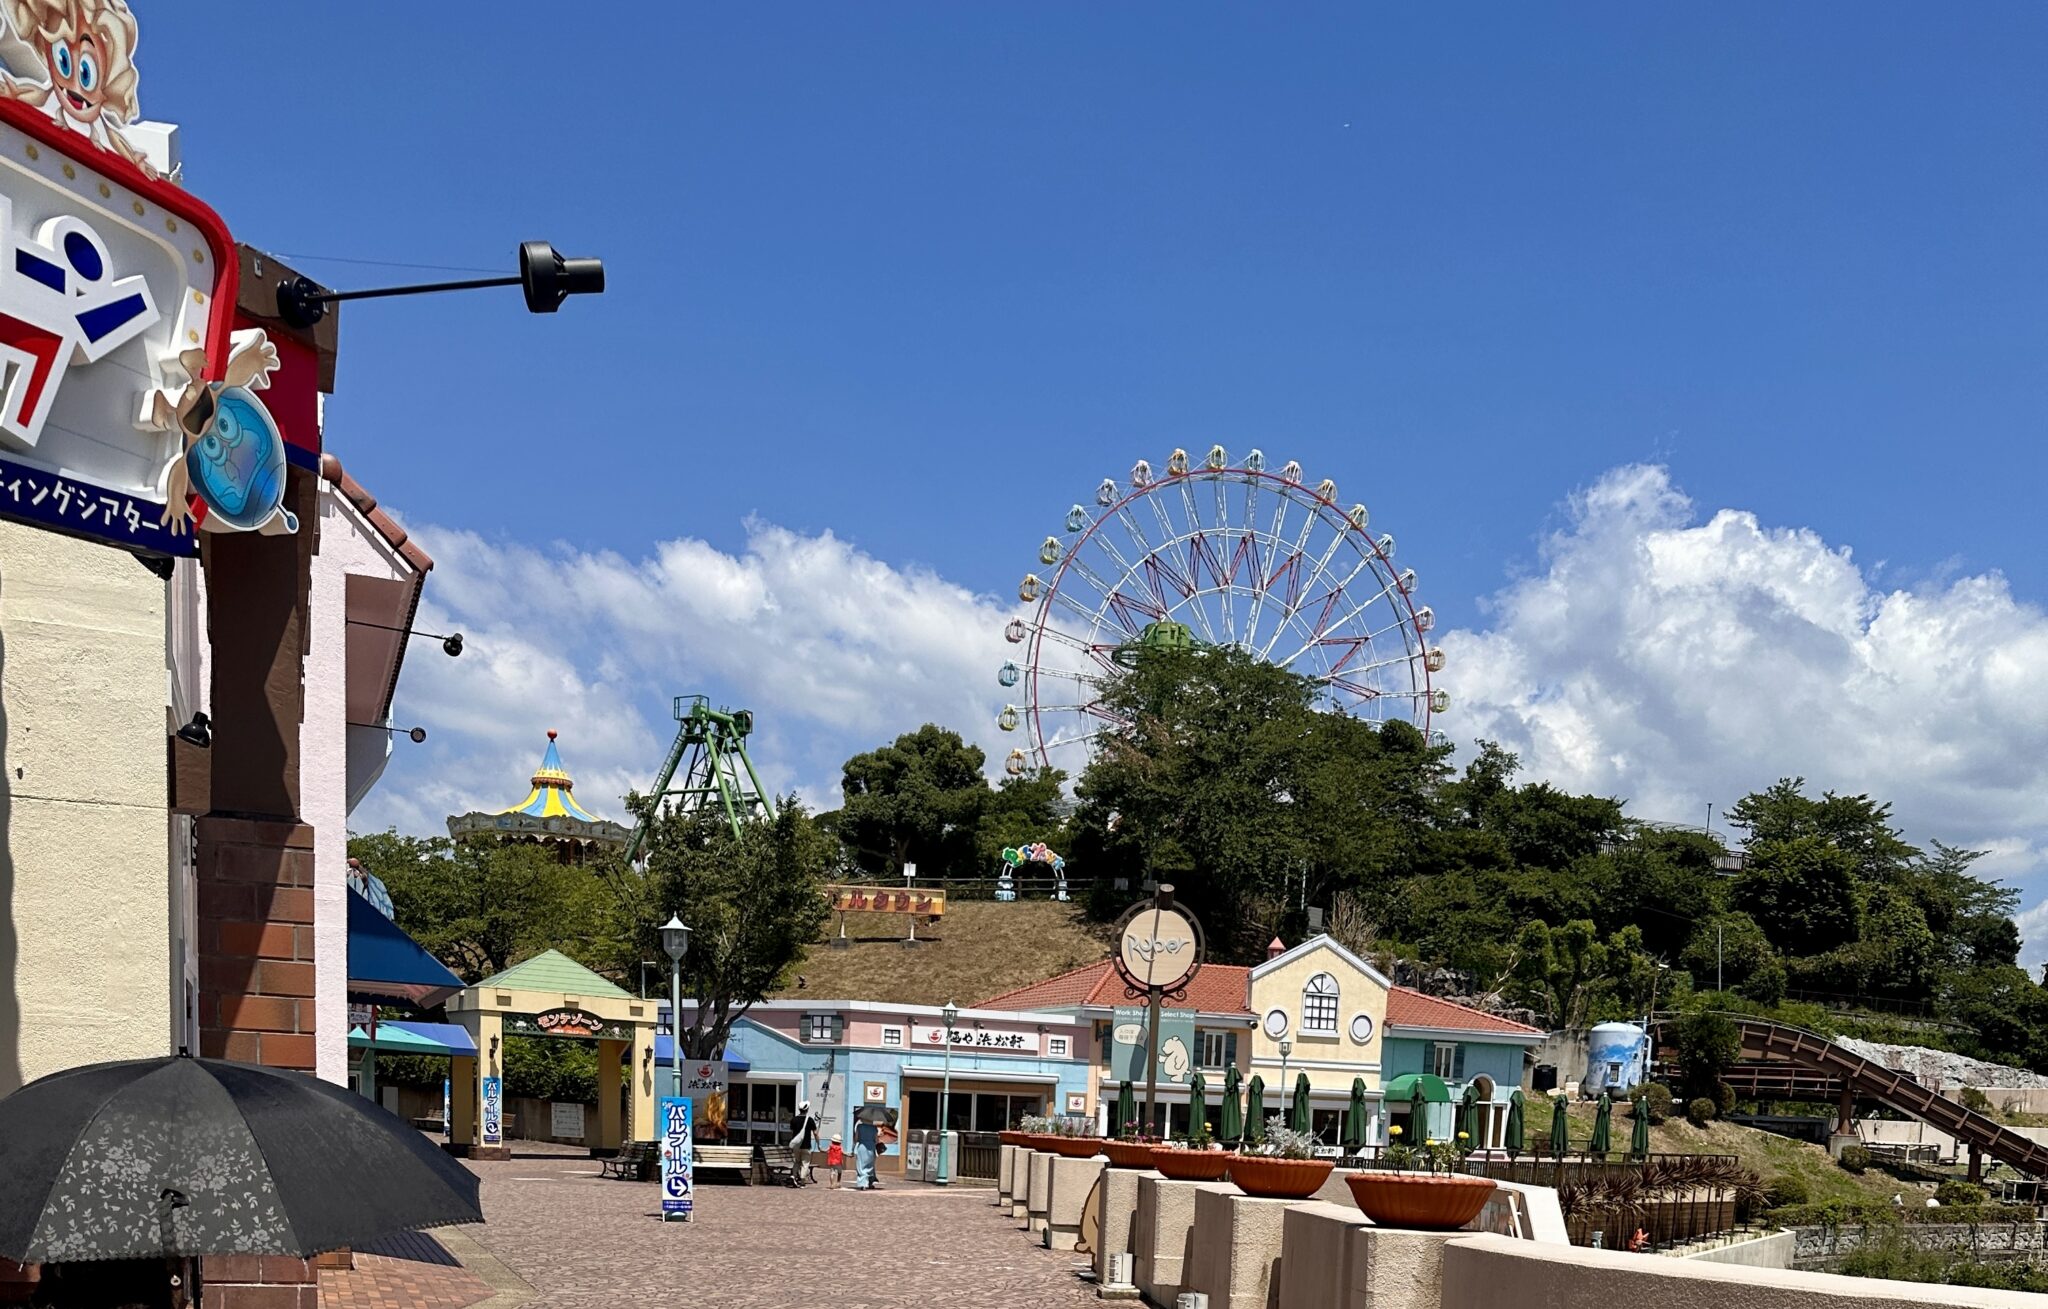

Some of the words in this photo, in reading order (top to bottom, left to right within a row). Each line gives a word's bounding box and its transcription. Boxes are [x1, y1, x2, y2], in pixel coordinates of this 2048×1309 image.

[0, 468, 160, 534] ィングシアター
[1126, 932, 1191, 963] Ruber
[668, 1105, 688, 1175] パルプール
